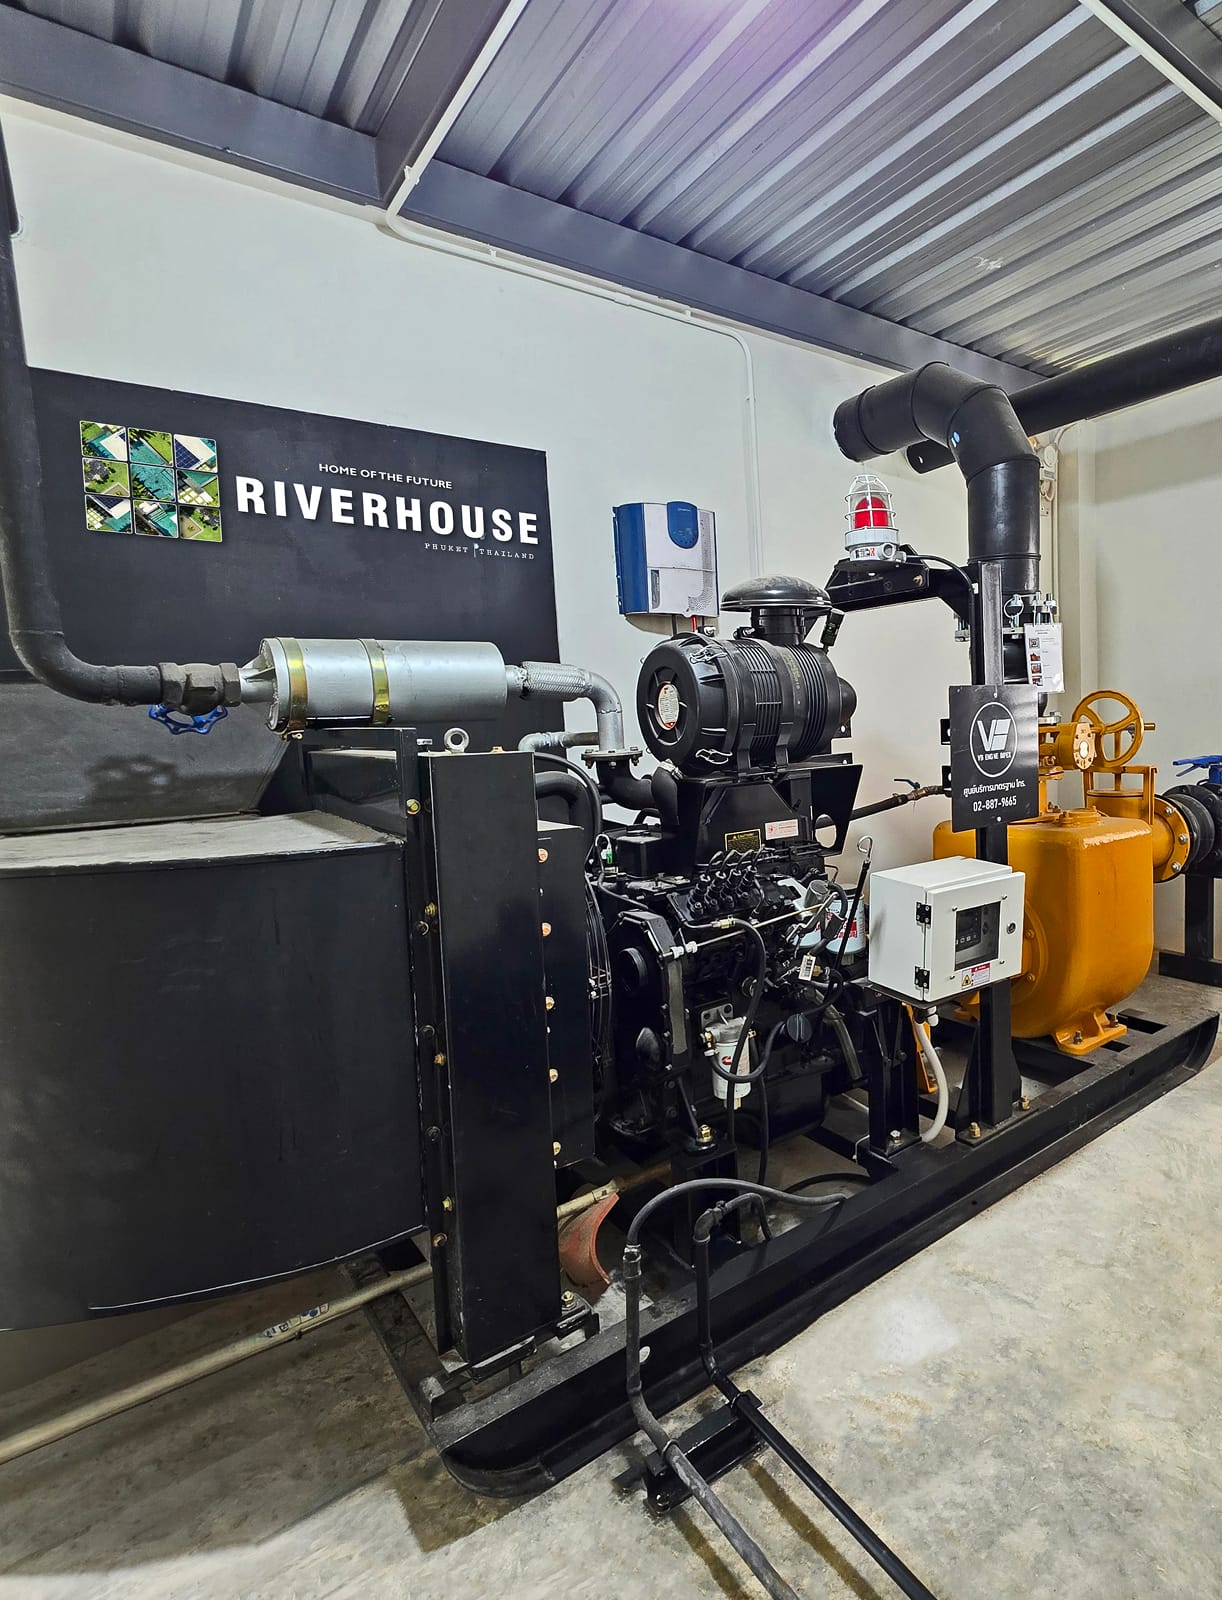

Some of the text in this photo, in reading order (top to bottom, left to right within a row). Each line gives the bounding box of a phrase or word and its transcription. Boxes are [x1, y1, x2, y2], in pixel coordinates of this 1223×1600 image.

[319, 463, 453, 489] HOME OF THE FUTURE
[235, 475, 539, 545] RIVERHOUSE
[424, 543, 535, 560] PHUKET THAILAND
[973, 796, 1017, 812] 02-887-9665
